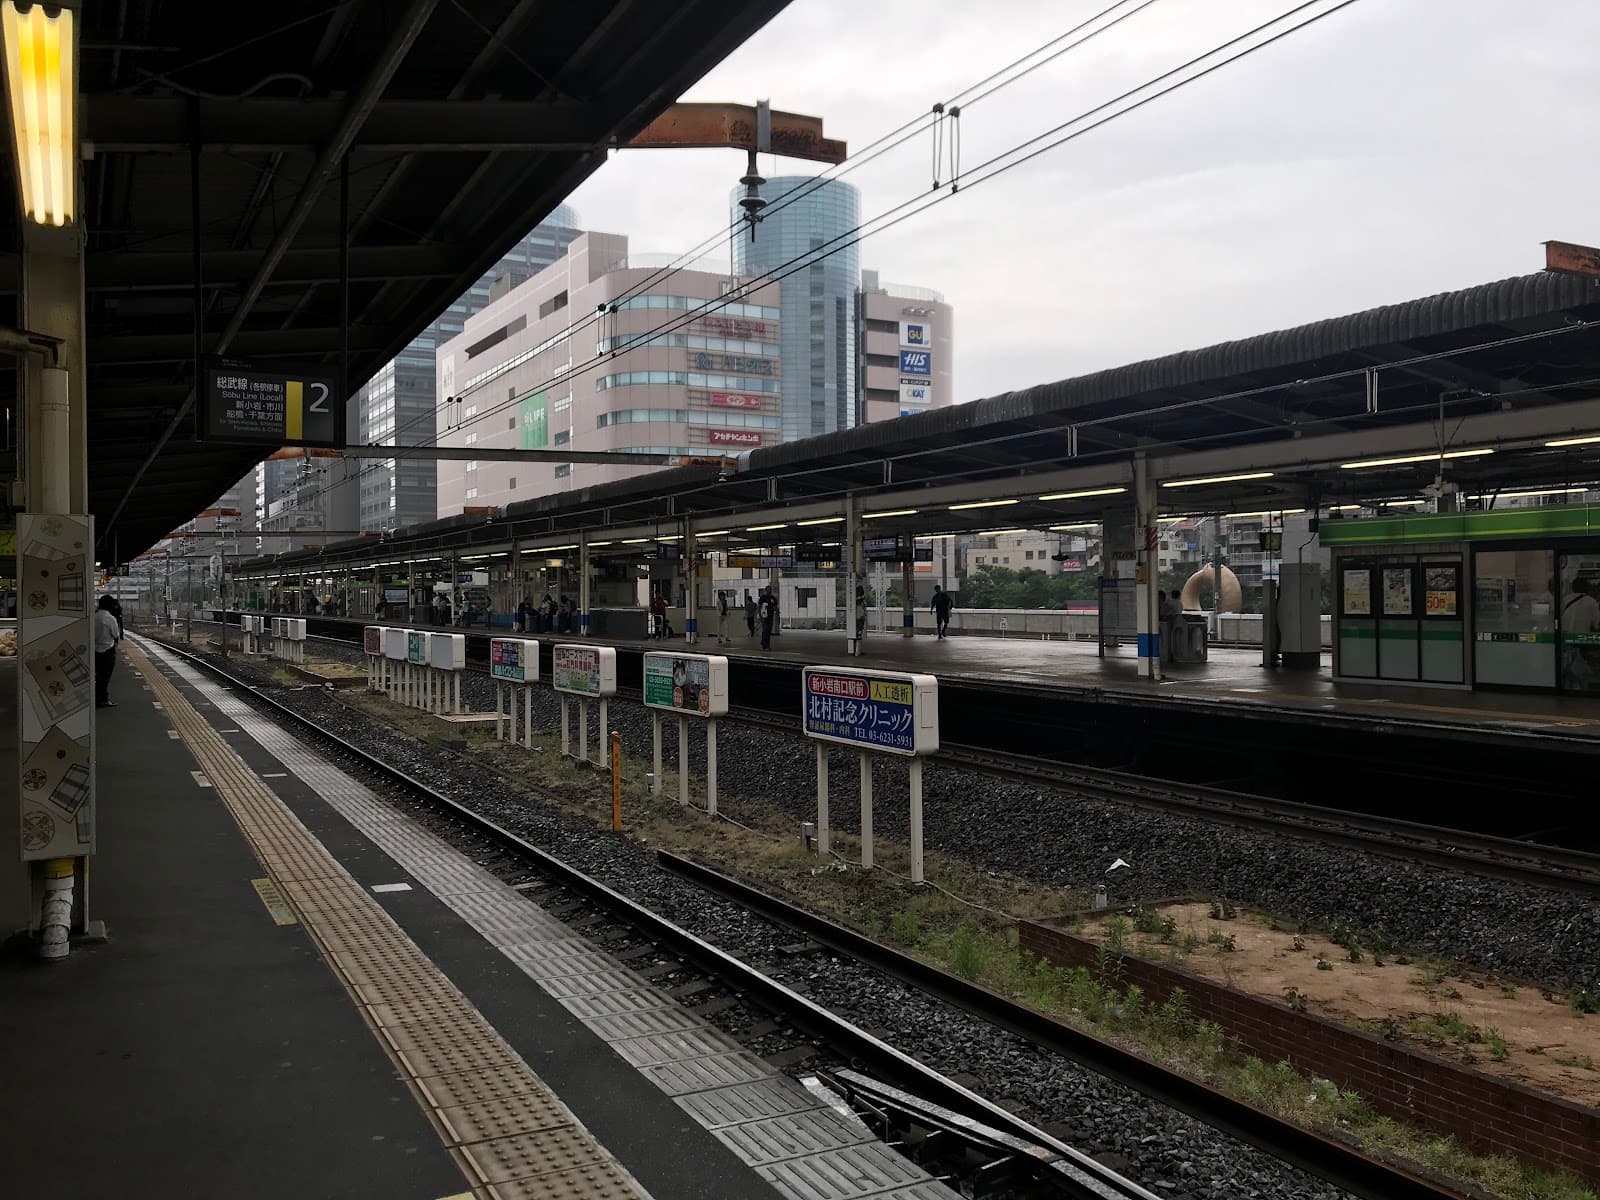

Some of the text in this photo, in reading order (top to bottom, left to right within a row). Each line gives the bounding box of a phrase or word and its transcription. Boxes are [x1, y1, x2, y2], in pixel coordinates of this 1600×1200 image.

[909, 330, 923, 340] GU
[904, 353, 927, 366] HIS
[242, 392, 258, 401] Line
[259, 393, 284, 402] (Local)
[309, 382, 329, 413] 2
[812, 677, 909, 702] 新小岩南口駅前 人工透析
[809, 695, 913, 732] 北村記念クリニック
[854, 727, 867, 739] TEL
